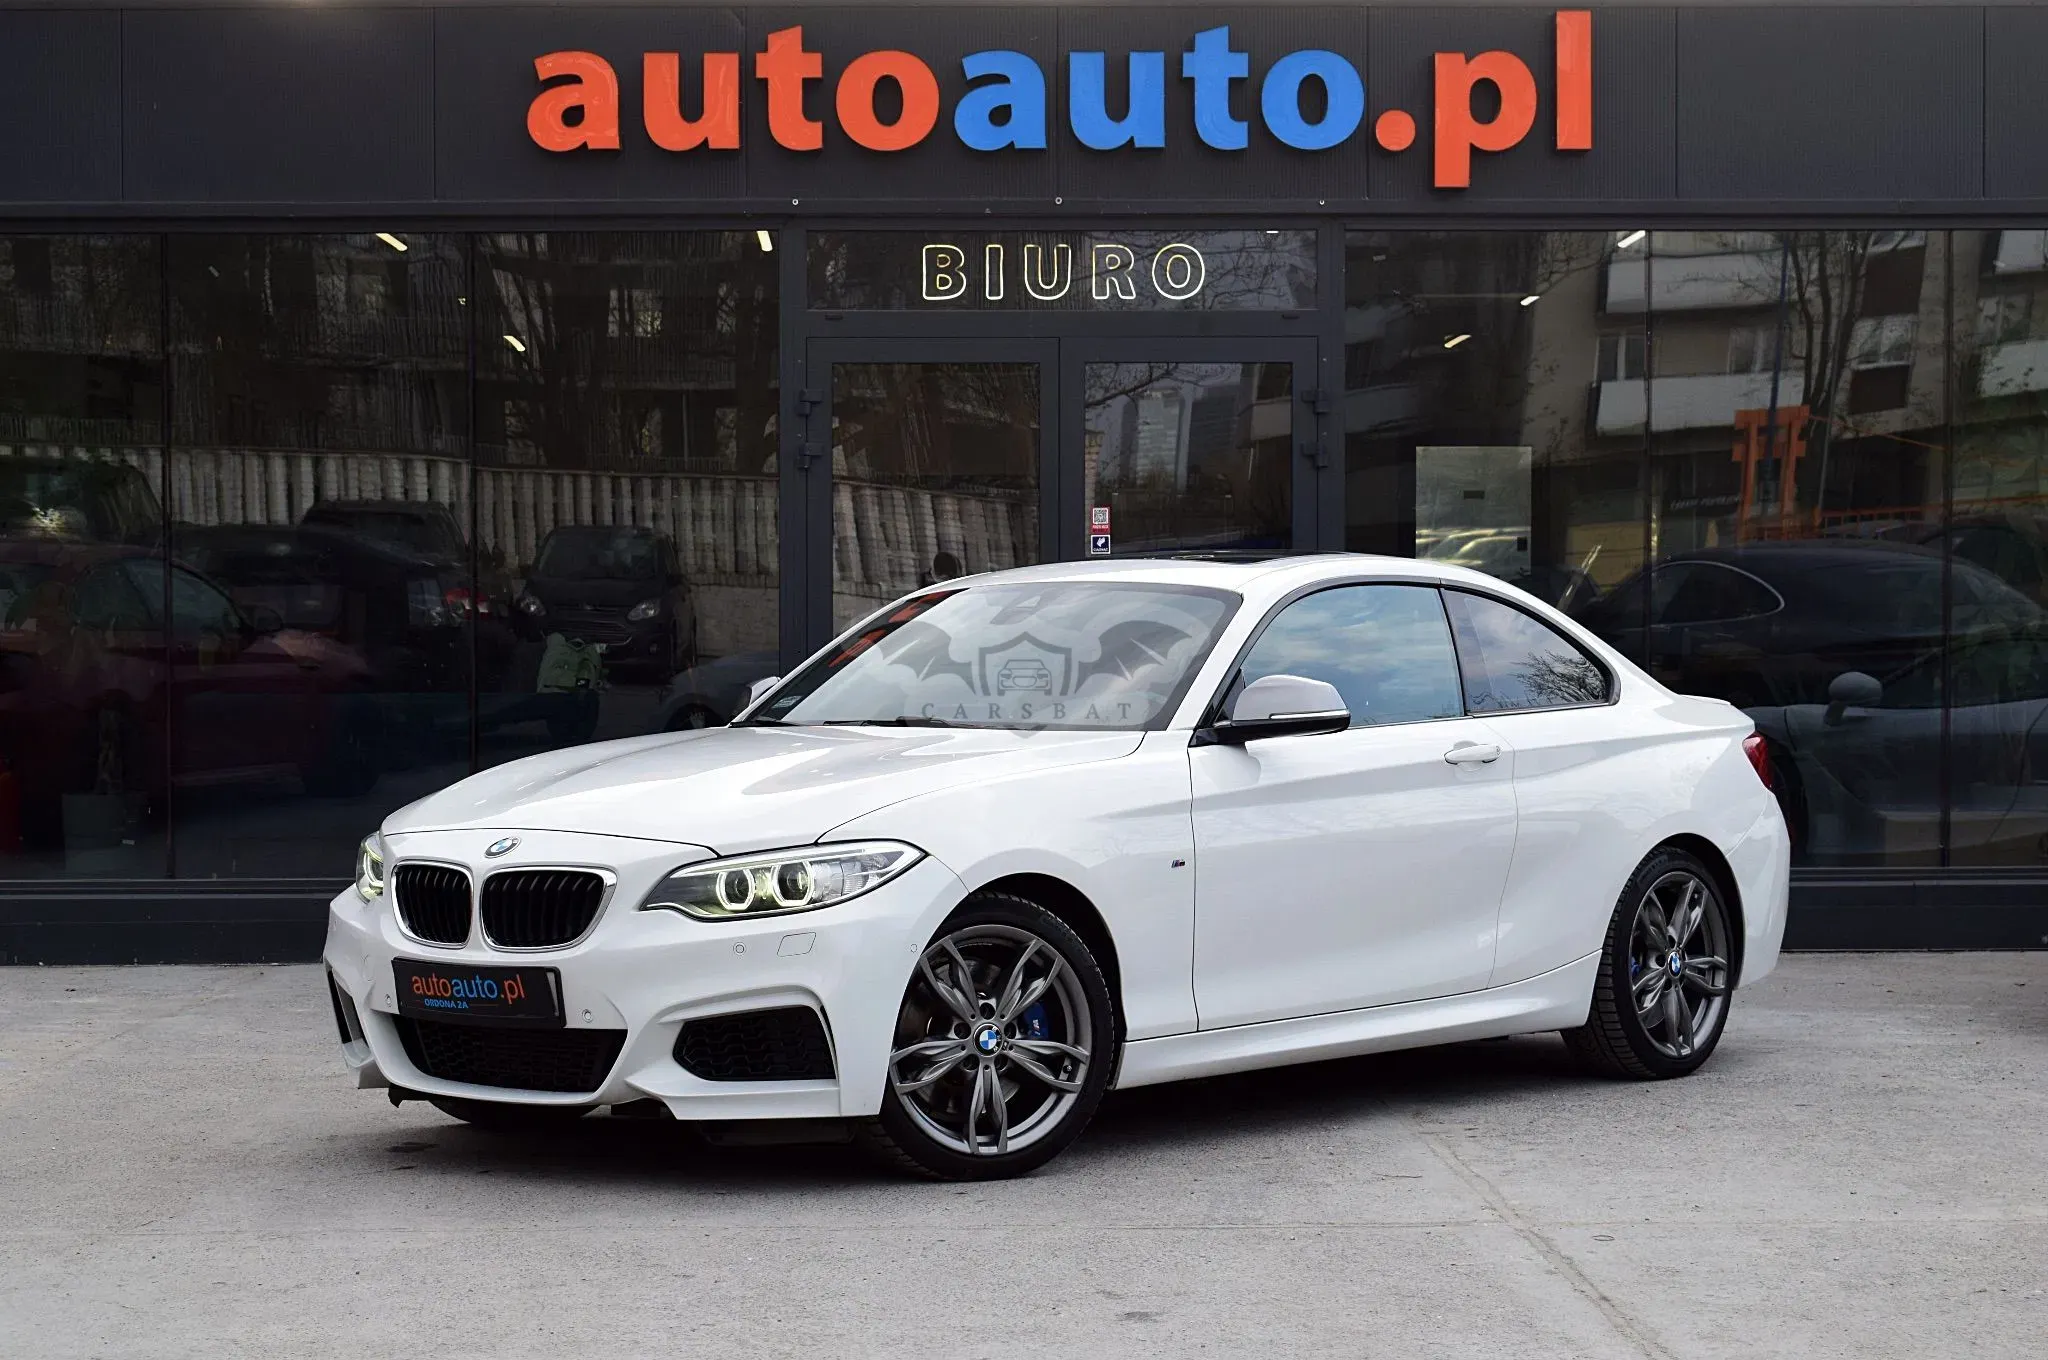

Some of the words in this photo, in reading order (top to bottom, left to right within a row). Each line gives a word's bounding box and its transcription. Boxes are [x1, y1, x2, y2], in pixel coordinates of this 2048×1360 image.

[527, 11, 1593, 188] autoauto.pl
[922, 243, 1206, 301] BIURO
[412, 973, 525, 1005] autoauto.pl
